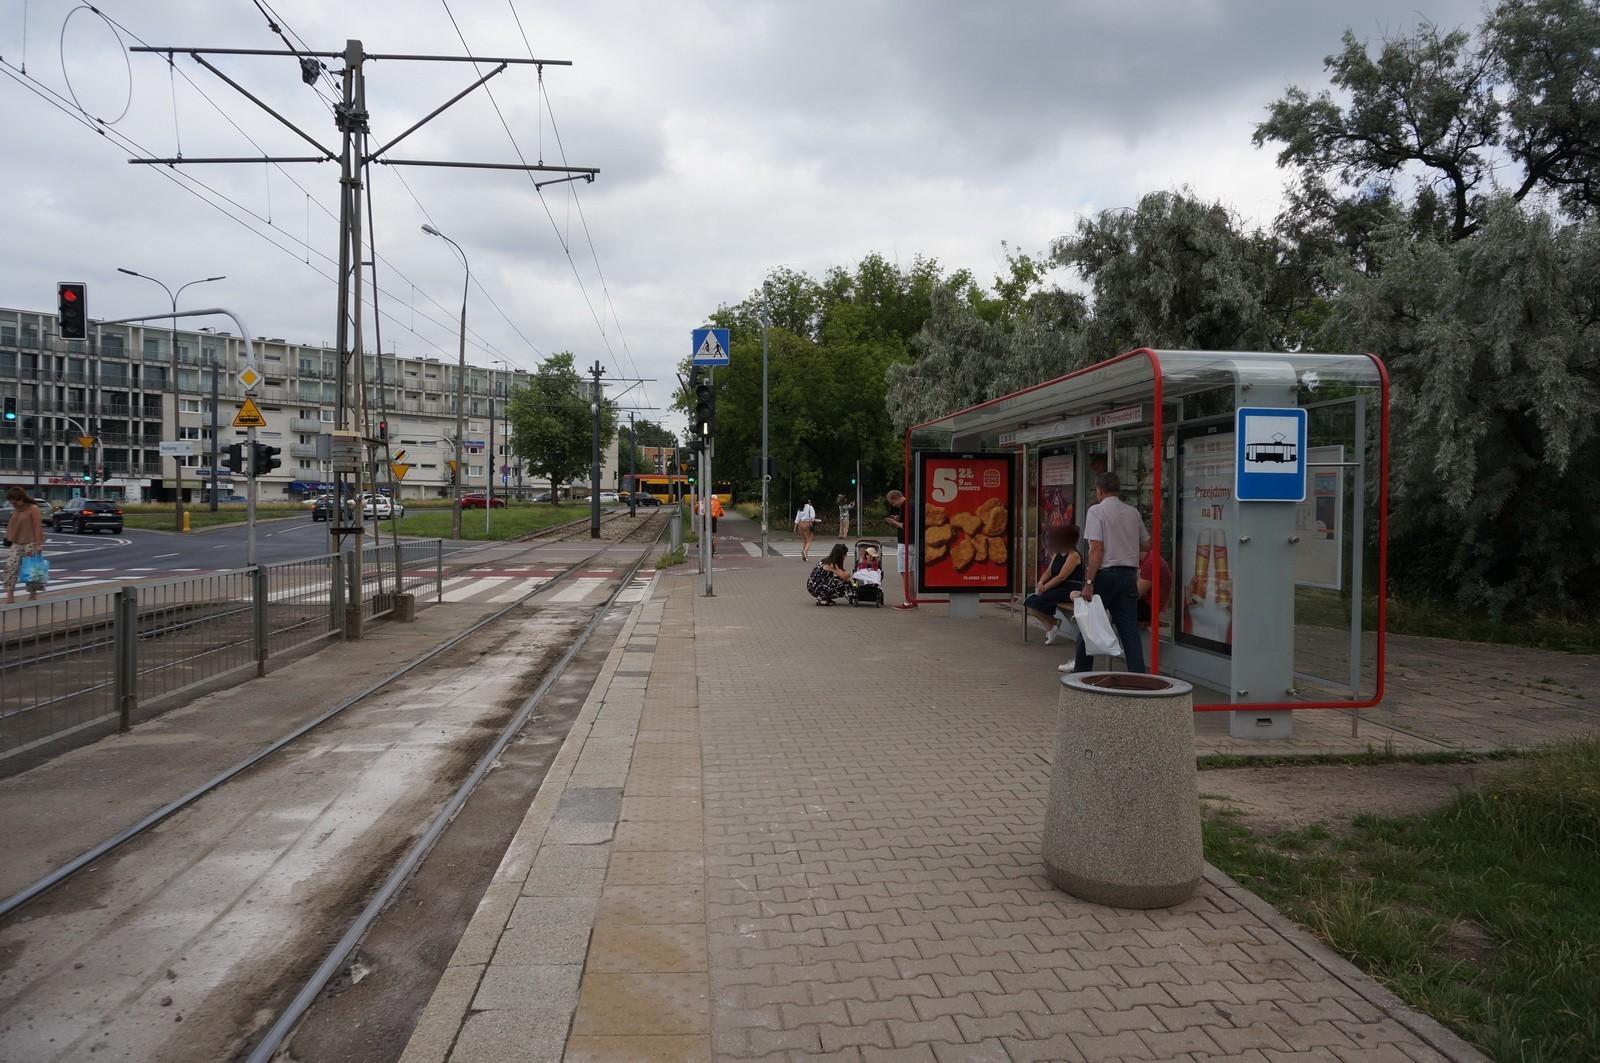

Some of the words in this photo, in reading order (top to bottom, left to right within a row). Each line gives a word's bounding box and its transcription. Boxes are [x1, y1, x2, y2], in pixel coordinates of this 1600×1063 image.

[931, 468, 958, 503] 5
[1201, 507, 1211, 518] na
[1211, 504, 1224, 520] TY
